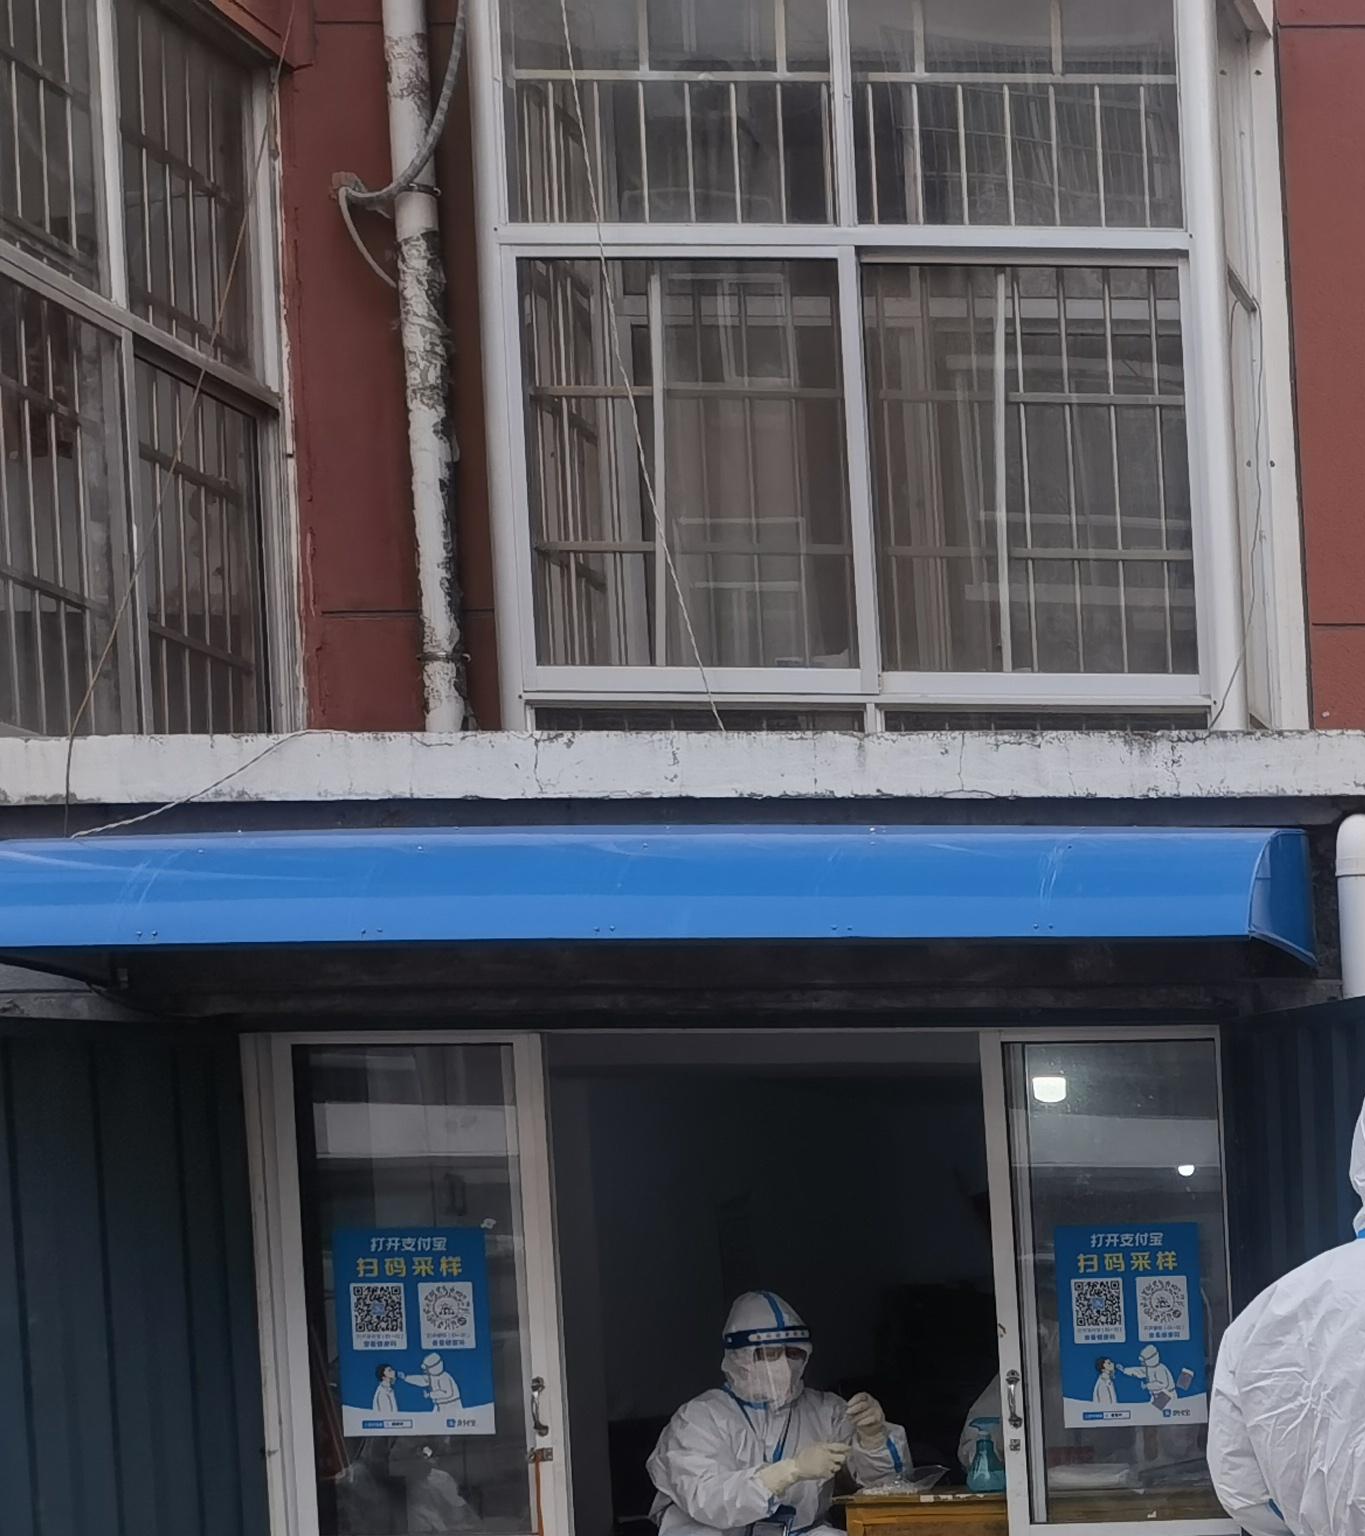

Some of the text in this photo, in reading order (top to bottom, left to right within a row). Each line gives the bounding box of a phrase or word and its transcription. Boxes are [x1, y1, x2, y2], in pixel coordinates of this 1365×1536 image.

[370, 1236, 447, 1252] 打开支付宝
[1090, 1232, 1164, 1248] 打开支付宝
[356, 1256, 463, 1278] 扫码采样
[1077, 1251, 1178, 1273] 扫码采样
